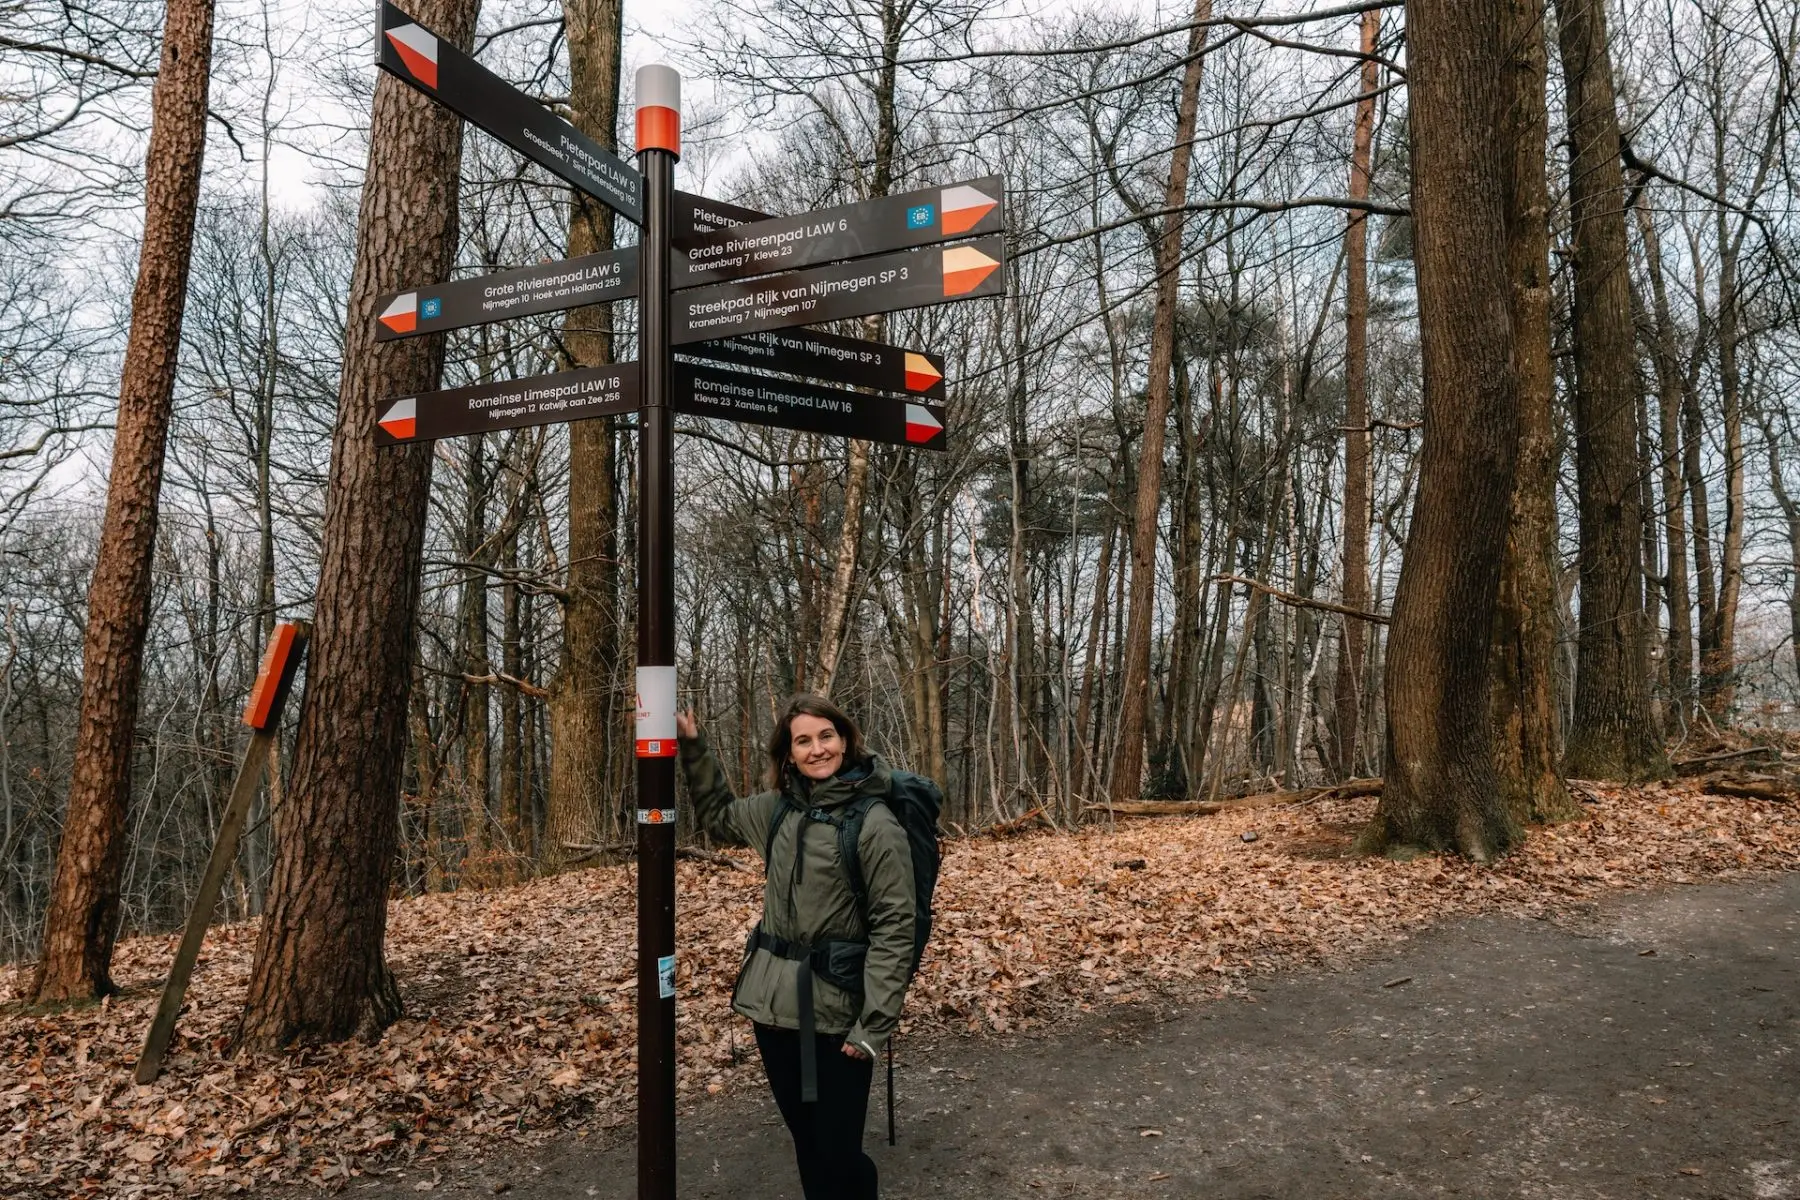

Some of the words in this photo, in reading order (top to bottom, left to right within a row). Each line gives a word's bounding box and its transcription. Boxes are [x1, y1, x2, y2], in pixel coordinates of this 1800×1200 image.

[523, 128, 564, 160] Groesbeek
[565, 154, 569, 162] 7
[573, 160, 586, 174] Sint
[588, 169, 624, 201] Pietersberg
[626, 194, 636, 206] 192
[560, 135, 607, 174] Pieterpad
[609, 167, 628, 188] LAW
[630, 181, 636, 192] 9
[694, 208, 751, 228] Pieterpa
[689, 244, 723, 259] Grote
[726, 227, 803, 252] Rivierenpad
[807, 221, 835, 237] LAW
[839, 219, 847, 231] 6
[689, 256, 742, 273] Kranenburg
[745, 254, 750, 262] 7
[754, 248, 779, 261] Kleve
[781, 246, 792, 255] 23
[482, 297, 520, 311] Nijmegen
[521, 294, 529, 302] 10
[533, 290, 552, 300] Hoek
[555, 287, 570, 296] van
[572, 280, 603, 294] Holland
[605, 277, 620, 288] 259
[485, 284, 514, 297] Grote
[517, 270, 582, 292] Rivierenpad
[586, 265, 610, 279] LAW
[613, 262, 620, 273] 6
[689, 293, 753, 315] Streekpad
[757, 289, 778, 305] Rijk
[782, 287, 807, 300] van
[811, 275, 876, 297] Nijmegen
[880, 270, 896, 283] SP
[900, 268, 908, 280] 3
[689, 312, 742, 329] Kranenburg
[745, 311, 750, 320] 7
[754, 304, 799, 319] Nijmegen
[802, 300, 816, 310] 107
[724, 340, 764, 355] Nijmegen
[766, 348, 775, 356] 16
[759, 332, 779, 347] Rijk
[782, 338, 802, 350] van
[806, 341, 857, 361] Nijmegen
[860, 352, 872, 362] SP
[875, 355, 881, 365] 3
[469, 394, 521, 409] Romeinse
[524, 383, 578, 400] Limespad
[582, 380, 606, 393] LAW
[608, 377, 620, 389] 16
[489, 406, 526, 419] Nijmegen
[539, 400, 567, 411] Katwijk
[570, 397, 586, 407] aan
[588, 396, 602, 404] Zee
[605, 392, 620, 402] 256
[694, 378, 754, 397] Romeinse
[757, 388, 813, 408] Limespad
[816, 397, 840, 411] LAW
[842, 402, 852, 413] 16
[694, 393, 718, 405] Kleve
[720, 397, 730, 406] 23
[735, 400, 765, 412] Xanten
[768, 405, 778, 414] 64
